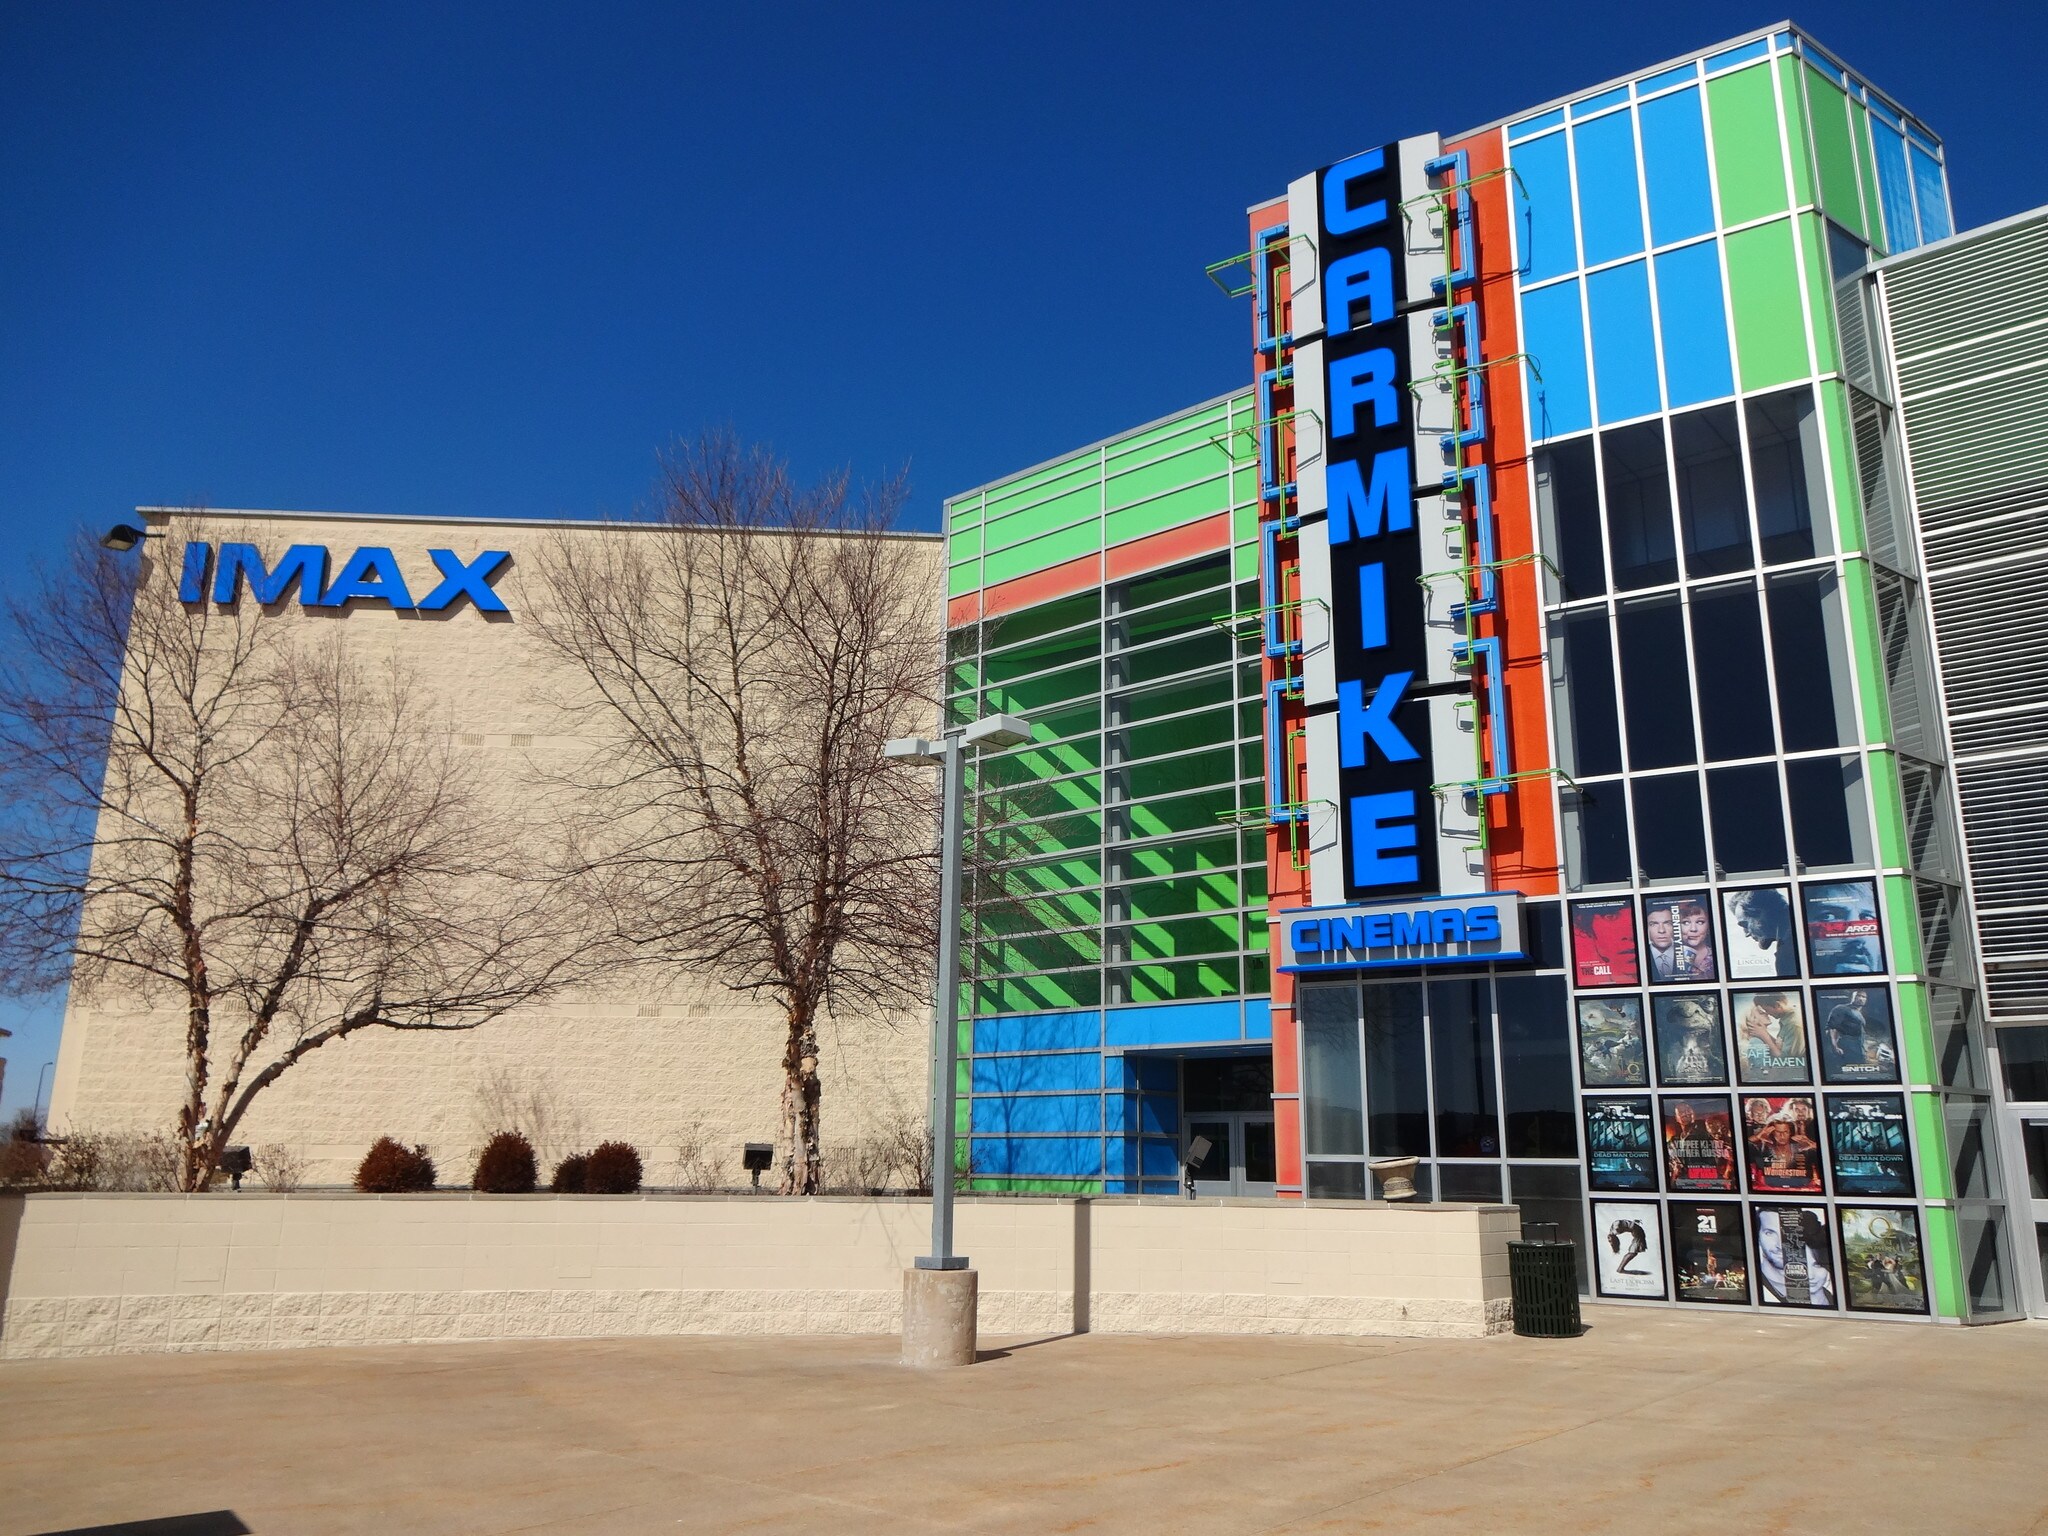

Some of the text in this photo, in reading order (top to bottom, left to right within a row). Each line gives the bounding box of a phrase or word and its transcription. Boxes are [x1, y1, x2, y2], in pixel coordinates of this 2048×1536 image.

[1321, 147, 1424, 888] CARMIKE
[178, 541, 512, 613] IMAX
[1291, 905, 1502, 953] CINEMAS
[1670, 905, 1683, 945] IDENTITY
[1845, 924, 1878, 933] ARGO
[1675, 945, 1686, 971] THIEF
[1737, 958, 1770, 966] LINCOLN
[1593, 966, 1612, 976] CALL
[1740, 1048, 1771, 1059] SAFE
[1762, 1057, 1806, 1067] HAVEN
[1697, 1215, 1717, 1229] 21
